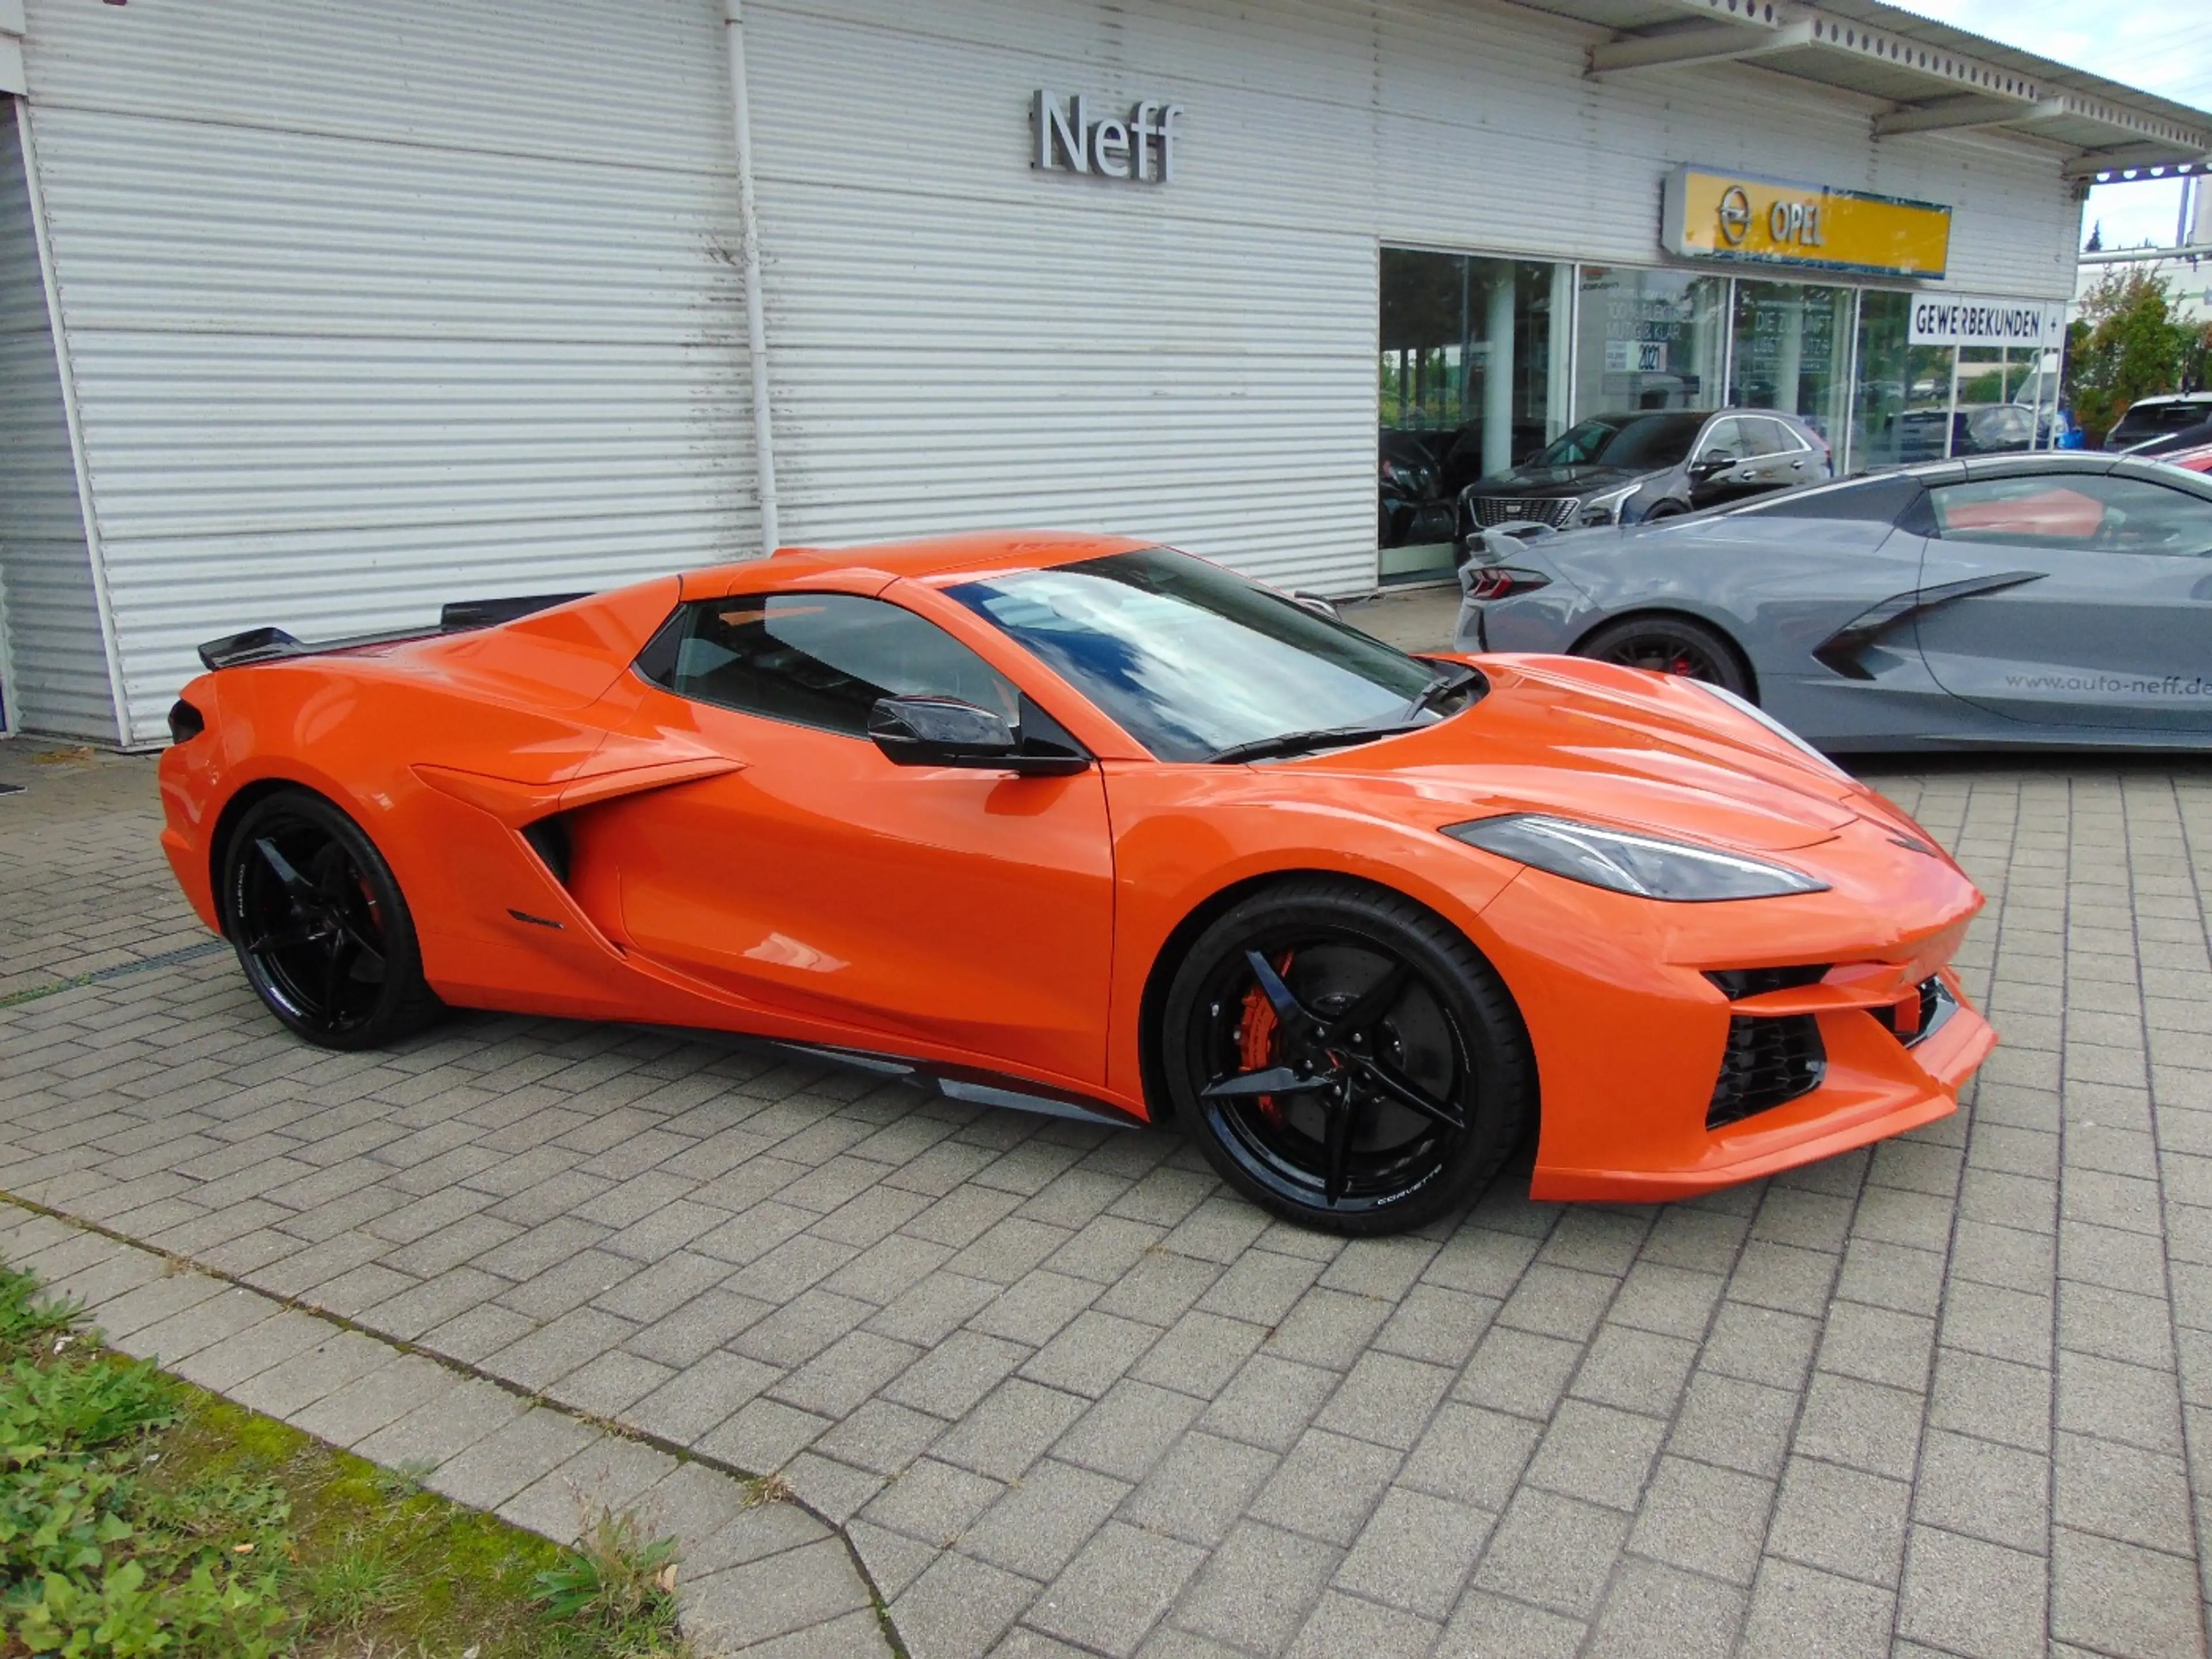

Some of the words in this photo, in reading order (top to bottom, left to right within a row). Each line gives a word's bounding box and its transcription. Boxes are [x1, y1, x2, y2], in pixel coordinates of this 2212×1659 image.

[1033, 89, 1184, 183] Neff
[1770, 199, 1826, 247] OPEL
[1916, 304, 2041, 338] GEWERBEKUNDEN
[2006, 675, 2212, 696] www.auto-neff.de
